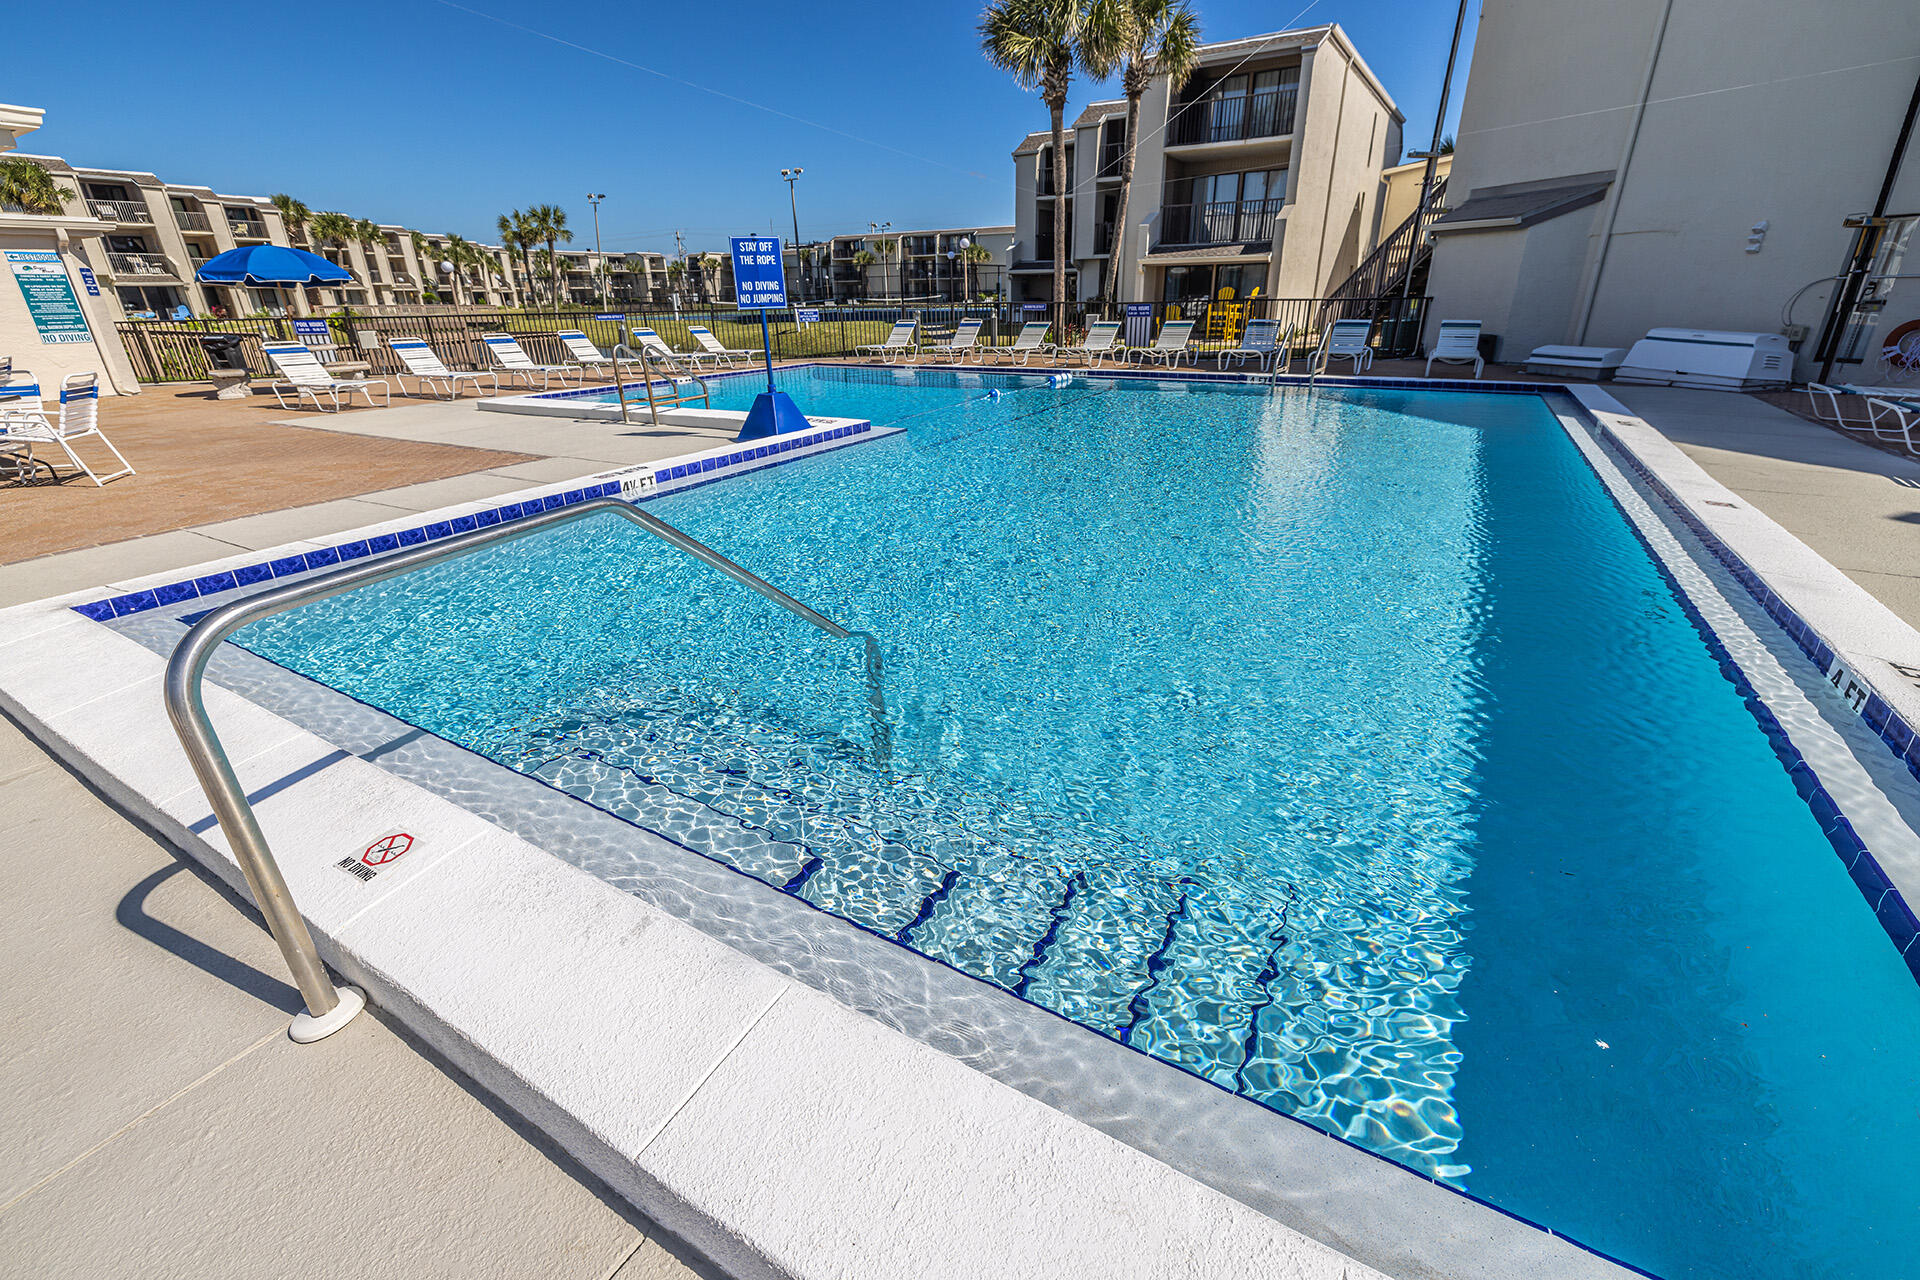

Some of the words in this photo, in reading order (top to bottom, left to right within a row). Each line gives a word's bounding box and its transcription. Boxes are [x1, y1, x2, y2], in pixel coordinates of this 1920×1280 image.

[739, 241, 757, 252] STAY
[759, 241, 773, 252] OFF
[739, 255, 754, 265] THE
[757, 255, 776, 265] ROPE
[742, 281, 753, 291] NO
[755, 281, 779, 291] DIVING
[740, 294, 751, 304] NO
[753, 293, 783, 304] JUMPING
[42, 334, 56, 342] NO
[58, 333, 91, 342] DIVING
[640, 475, 654, 487] FT
[1831, 669, 1844, 689] 4
[1844, 680, 1867, 711] FT
[337, 856, 356, 869] NO
[347, 862, 377, 882] DIVING
